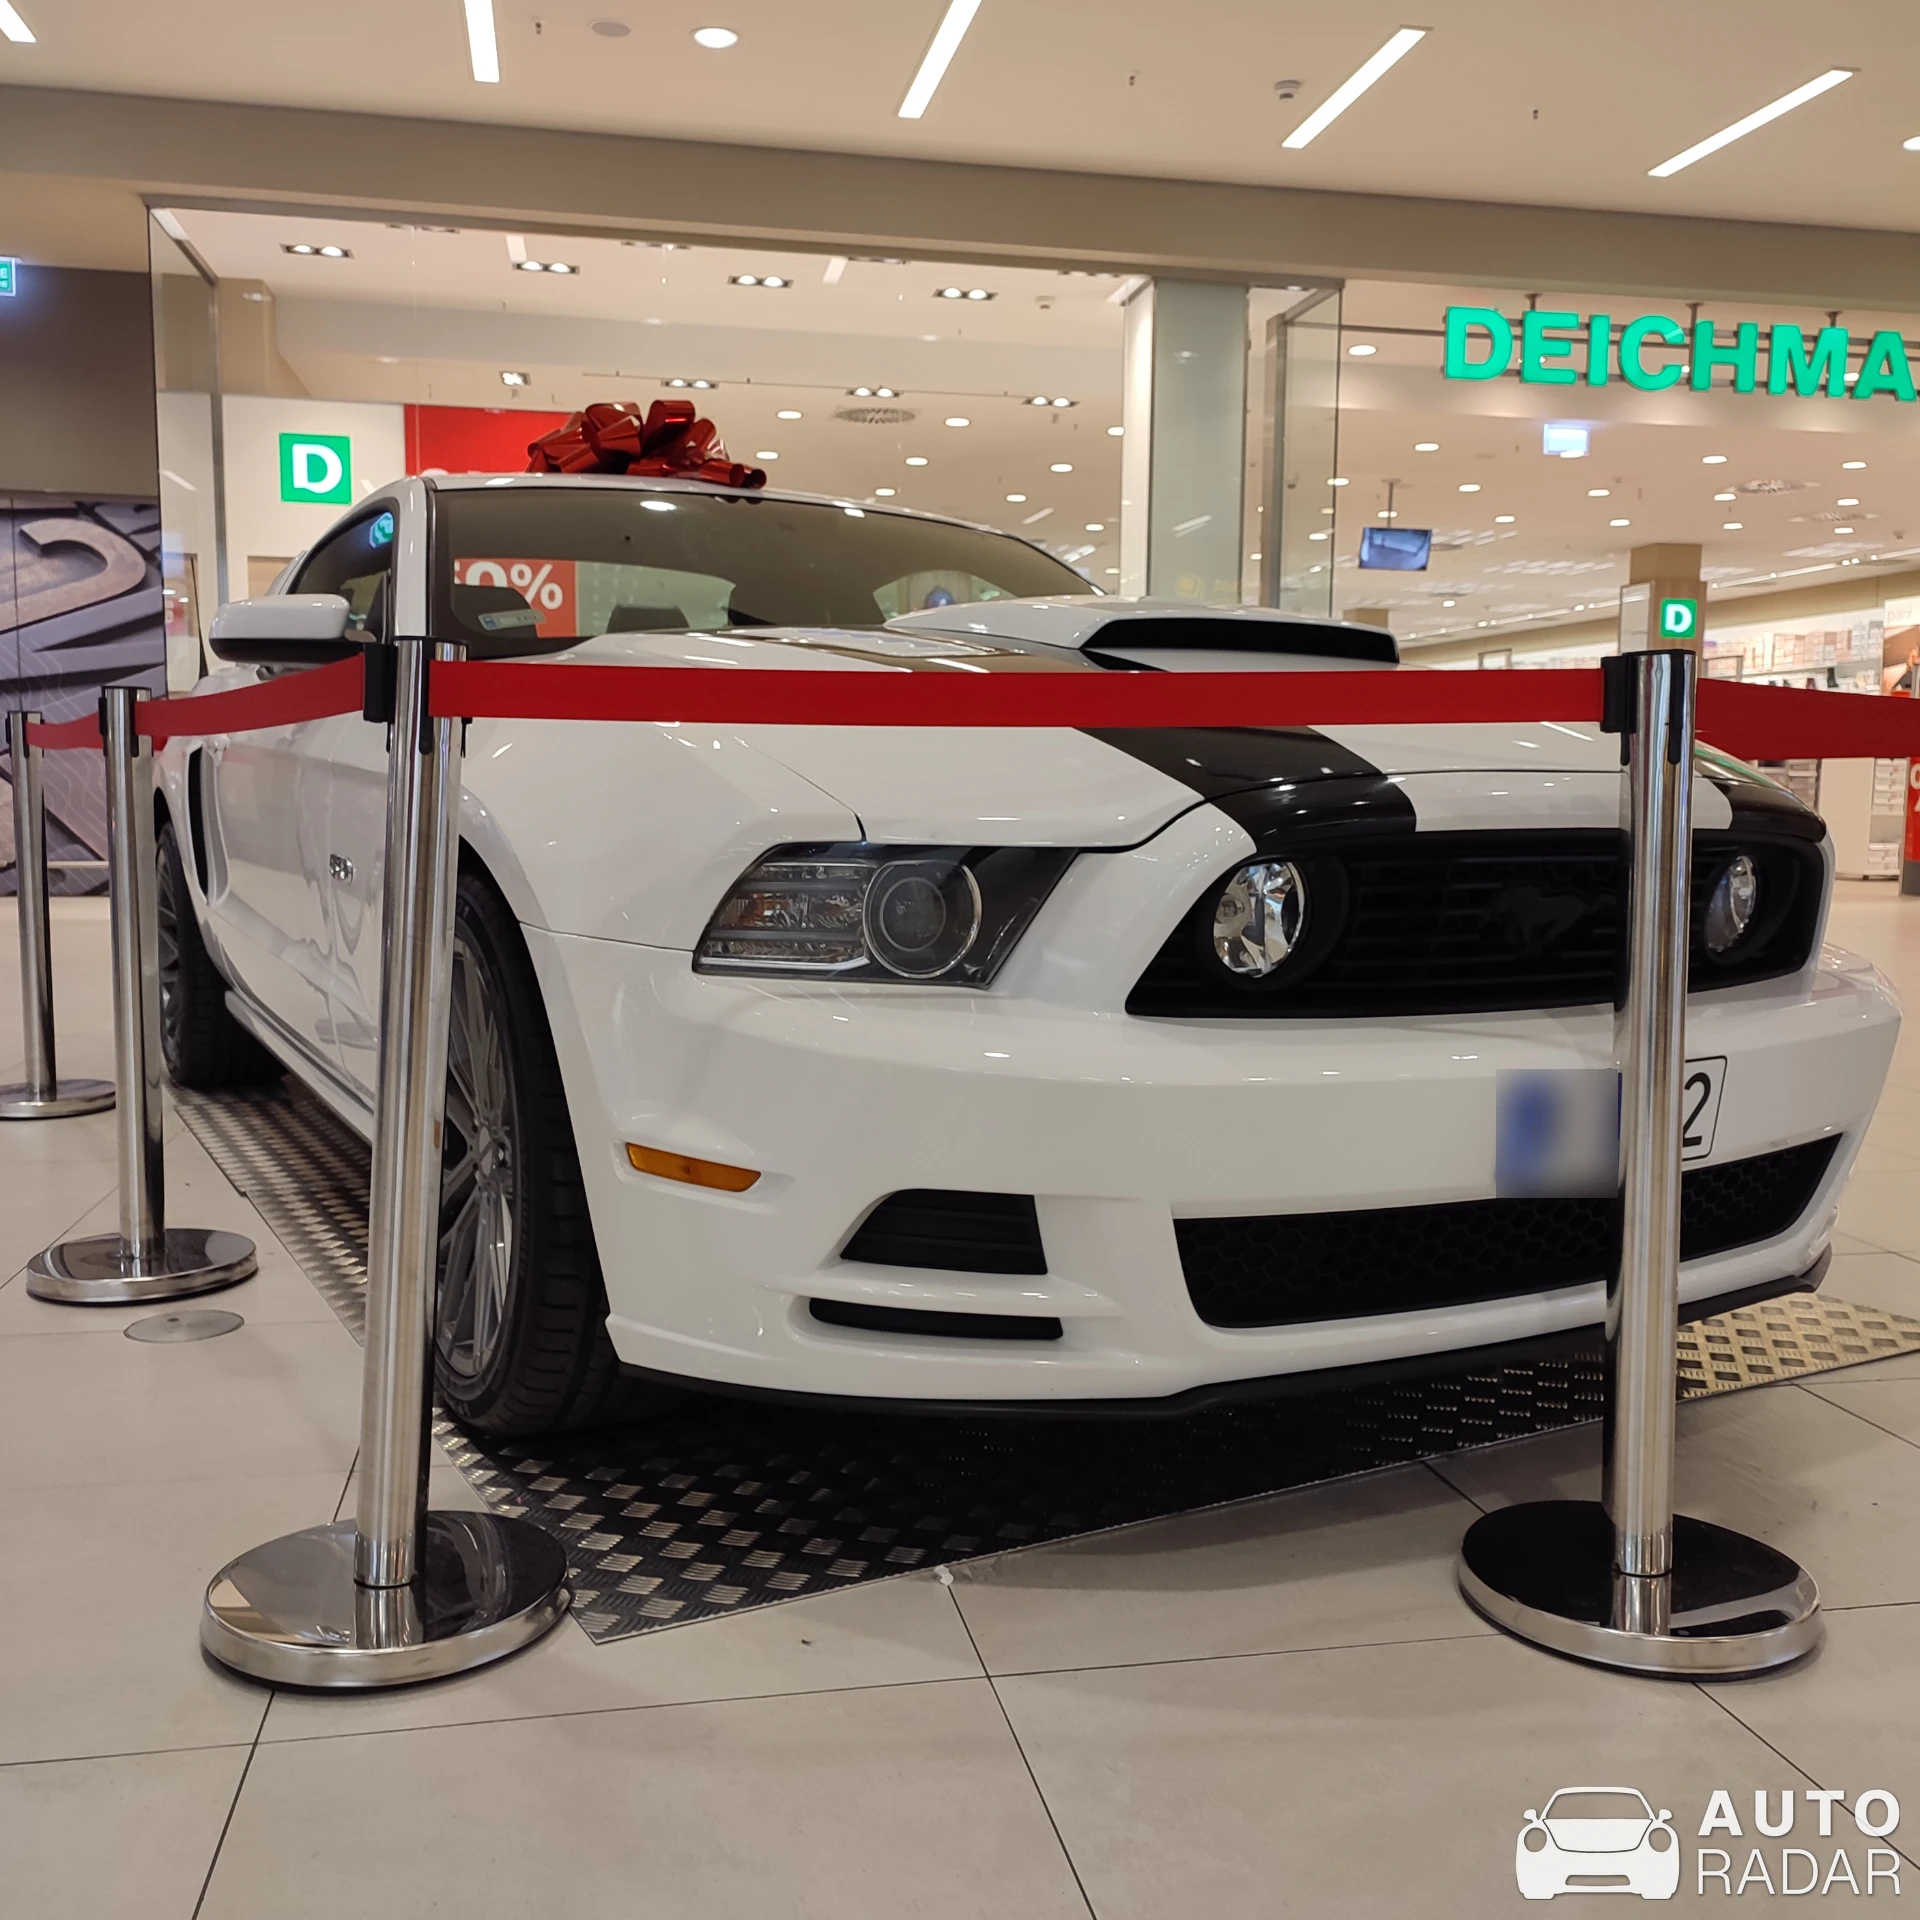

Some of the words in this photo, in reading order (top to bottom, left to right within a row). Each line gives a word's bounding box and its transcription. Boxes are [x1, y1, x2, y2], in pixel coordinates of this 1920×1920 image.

[1444, 306, 1917, 402] DEICHMA
[293, 444, 342, 493] D
[1666, 605, 1692, 632] D
